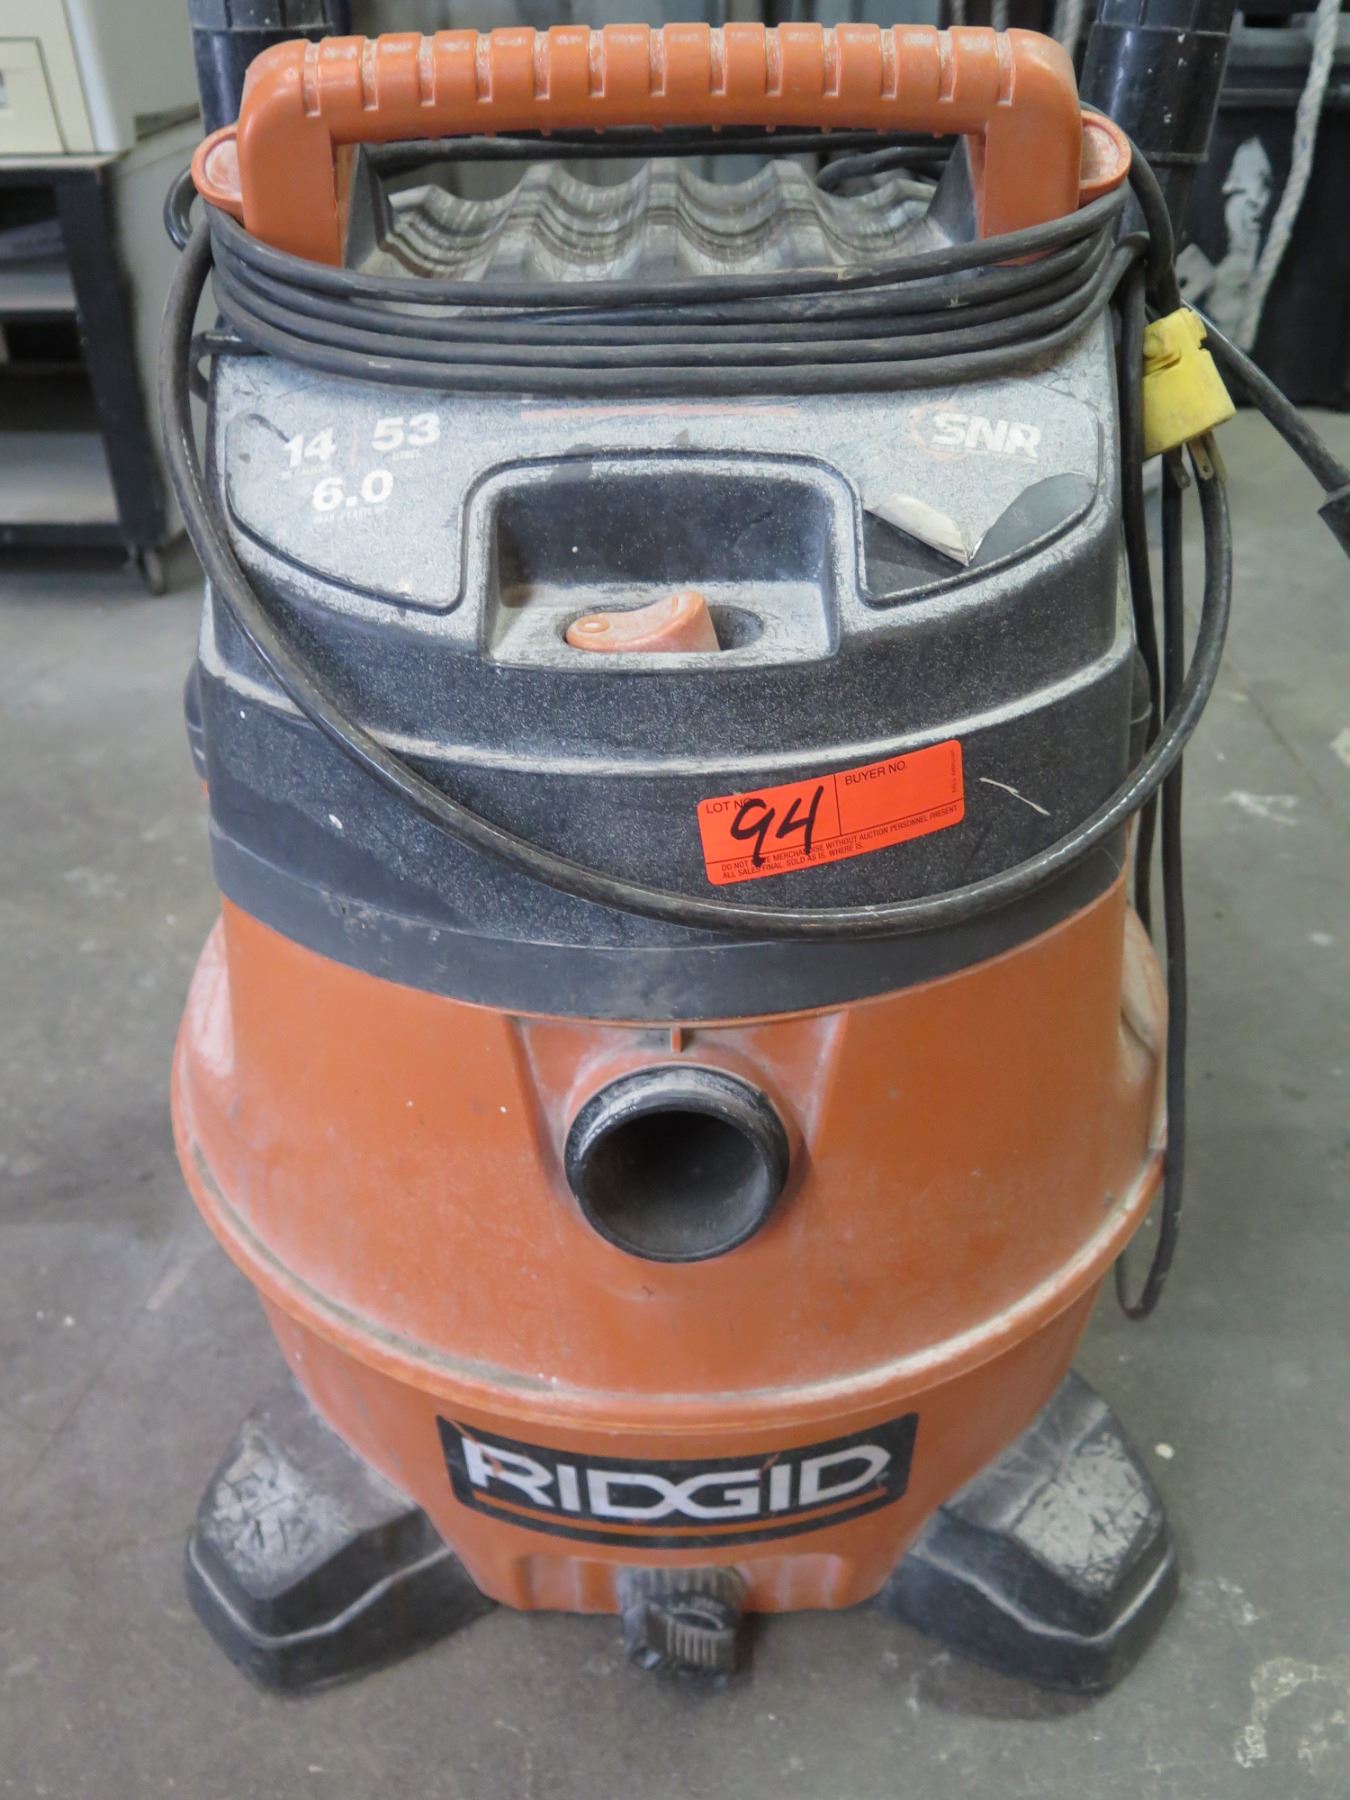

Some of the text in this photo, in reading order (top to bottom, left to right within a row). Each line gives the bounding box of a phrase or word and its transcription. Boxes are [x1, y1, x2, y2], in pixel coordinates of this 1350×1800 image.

[284, 427, 337, 467] 14
[371, 412, 441, 451] 53
[932, 412, 1040, 458] SNR
[312, 468, 394, 512] 6.0
[845, 767, 886, 785] BUYER
[706, 801, 730, 814] LOT
[730, 785, 824, 869] 94
[721, 862, 733, 872] DO
[734, 860, 749, 869] NOT
[825, 834, 857, 850] WITHOUT
[859, 825, 888, 841] AUCTION
[889, 815, 928, 832] PERSONNEL
[722, 868, 736, 878] ALL
[786, 855, 806, 867] SOLD
[828, 843, 854, 857] WHERE
[461, 1436, 892, 1520] RIDGID
